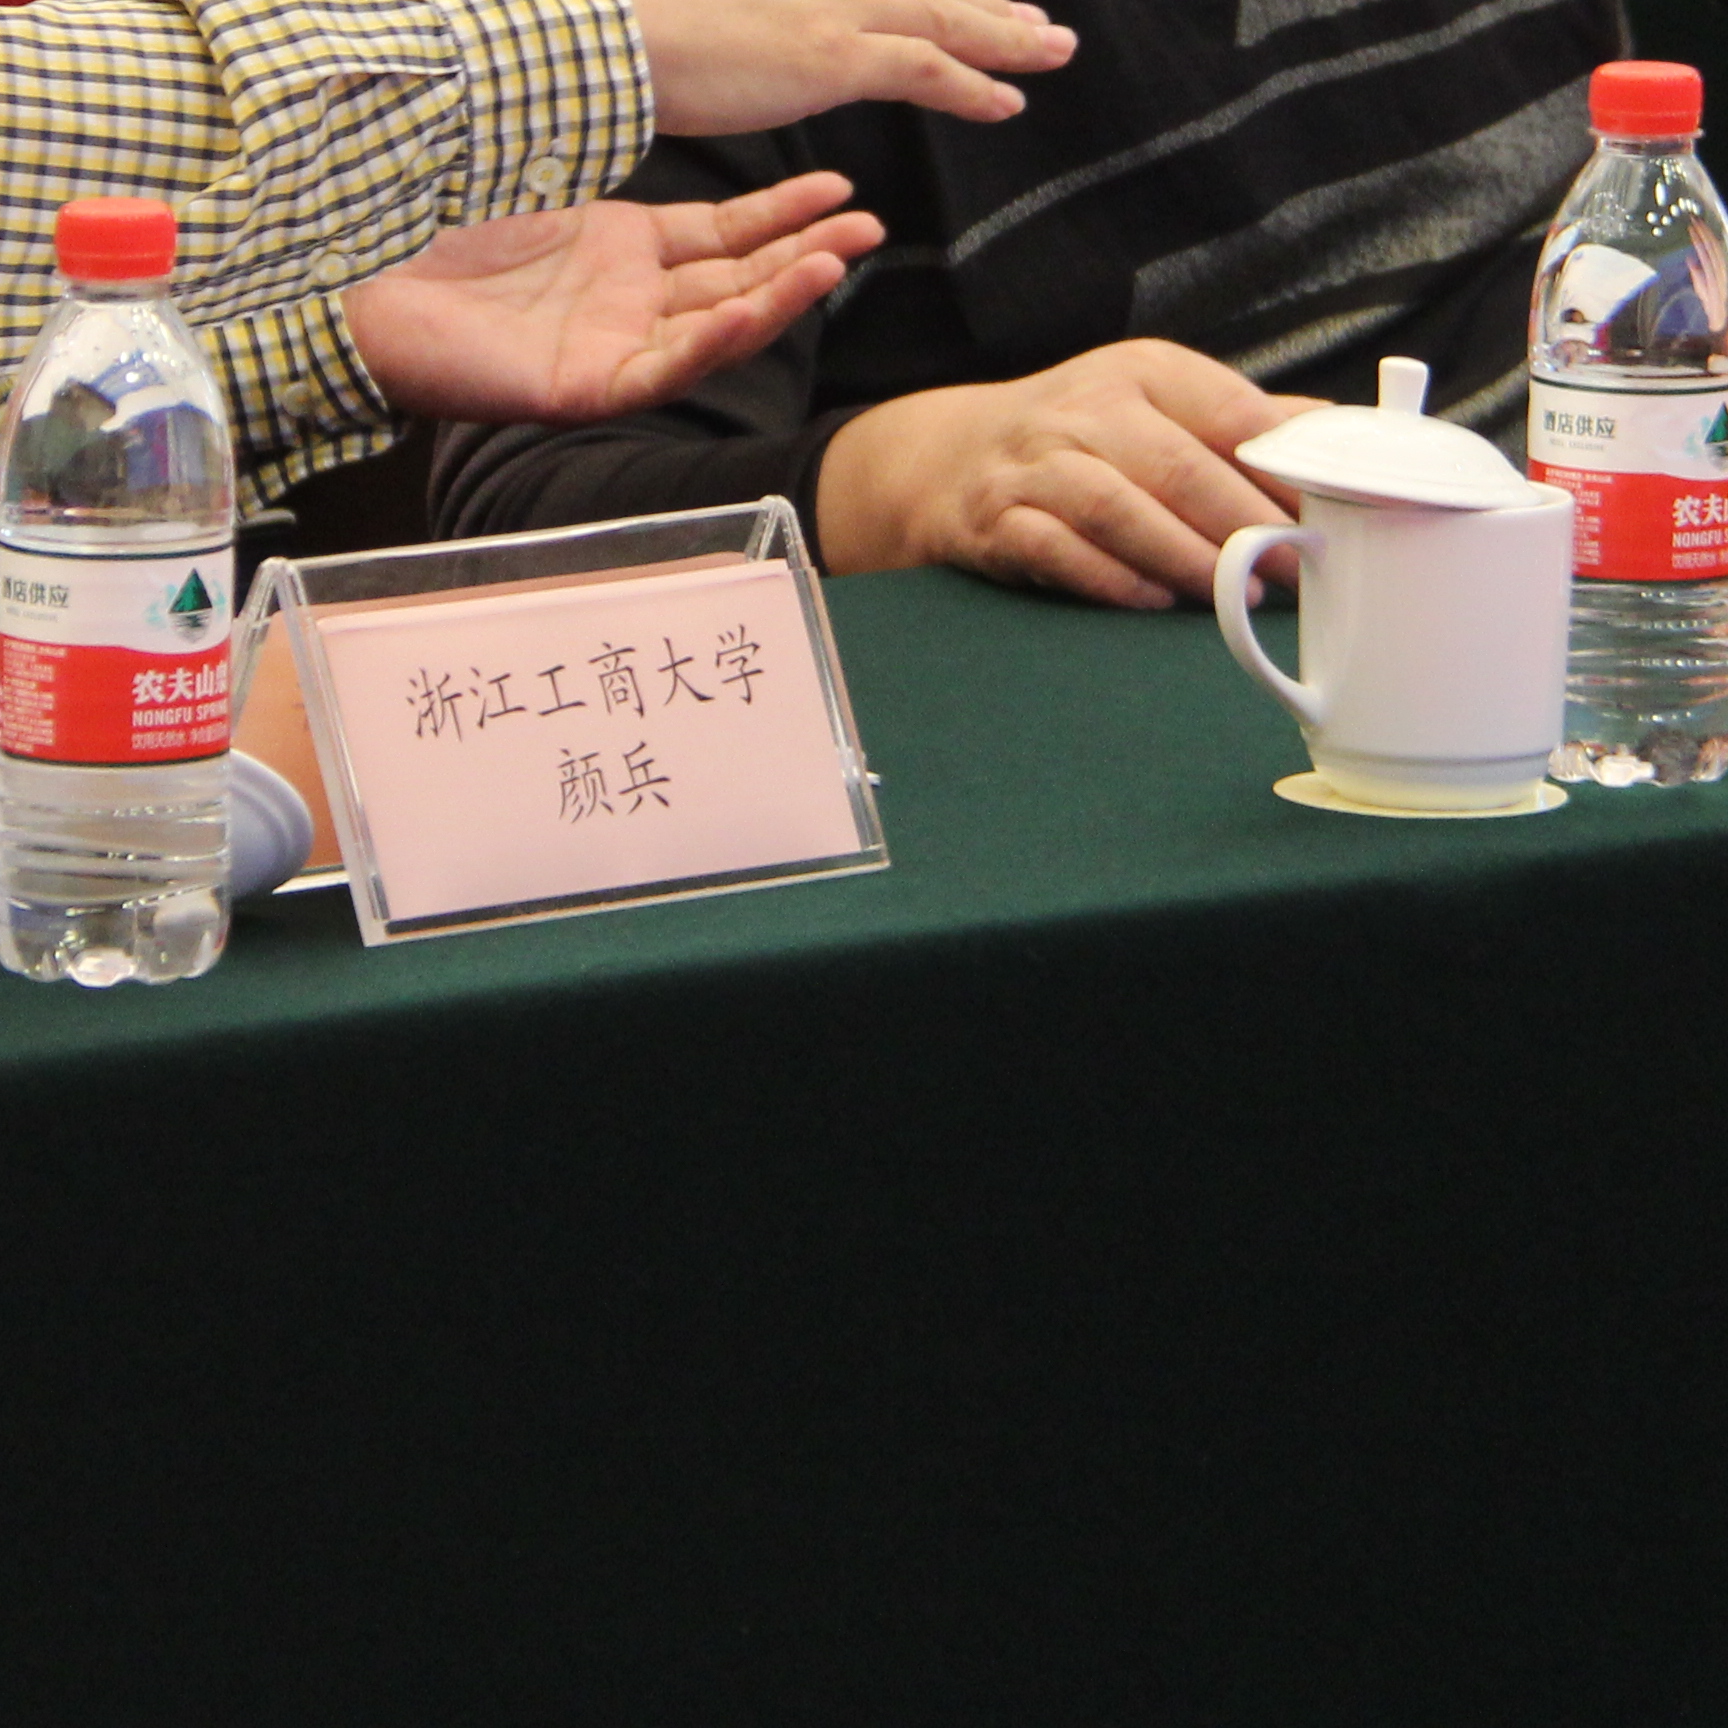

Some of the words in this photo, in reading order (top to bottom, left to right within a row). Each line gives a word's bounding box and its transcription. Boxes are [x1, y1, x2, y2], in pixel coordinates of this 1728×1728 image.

[1672, 529, 1723, 548] NONGFU
[405, 623, 765, 742] 浙江工商大学
[132, 706, 192, 727] NONGFU
[557, 740, 672, 824] 颜兵
